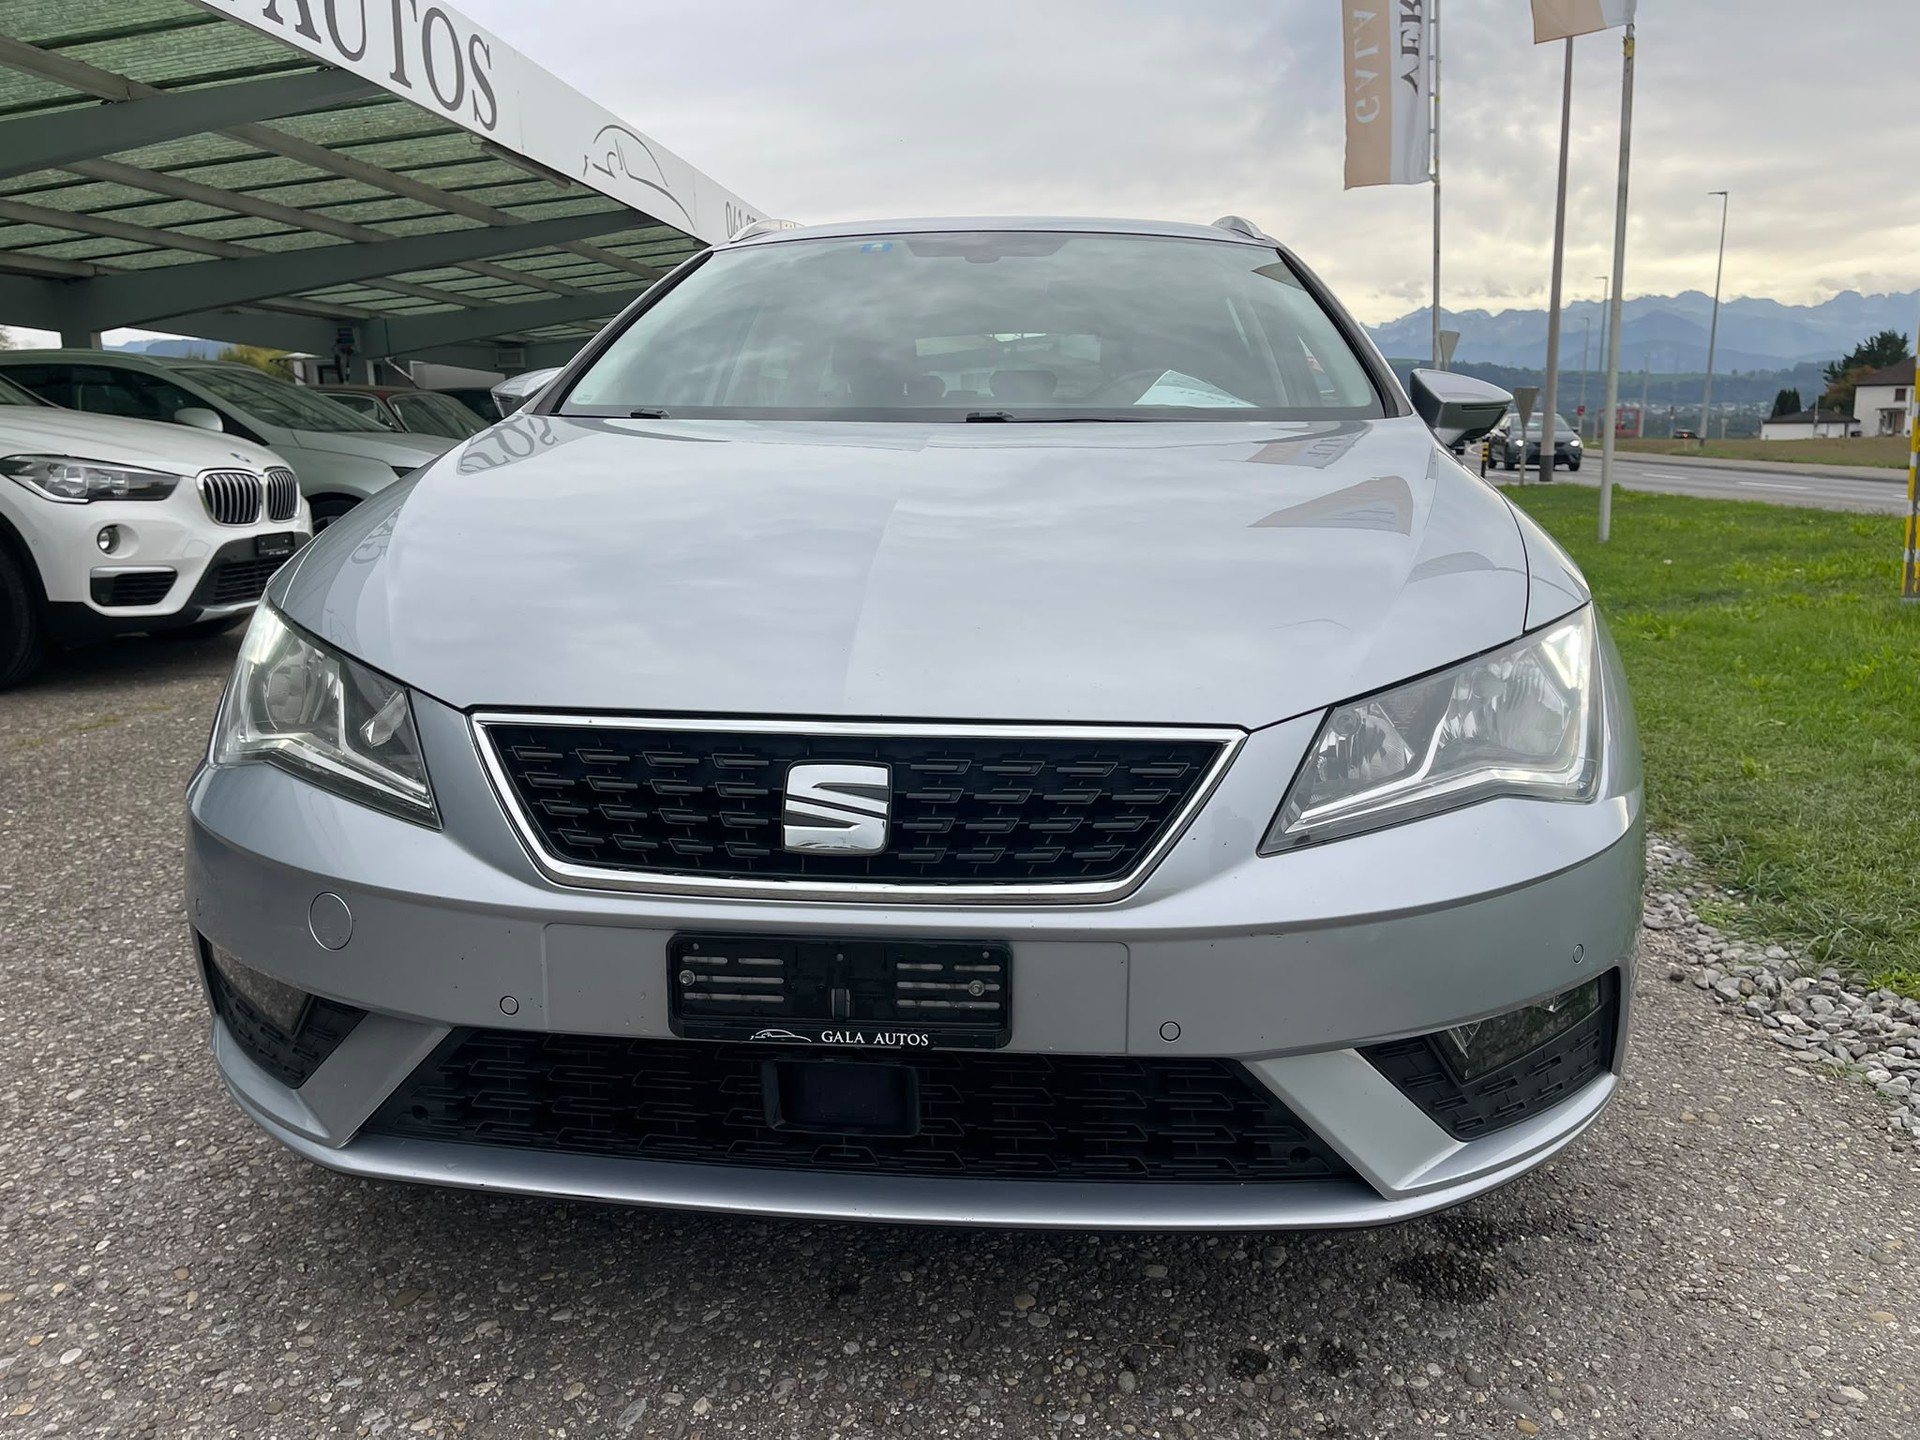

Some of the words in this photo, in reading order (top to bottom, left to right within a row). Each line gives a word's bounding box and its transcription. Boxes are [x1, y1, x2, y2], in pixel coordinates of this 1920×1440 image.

[262, 0, 497, 131] UTOS
[821, 1030, 865, 1044] GALA
[874, 1032, 929, 1046] AUTOS
